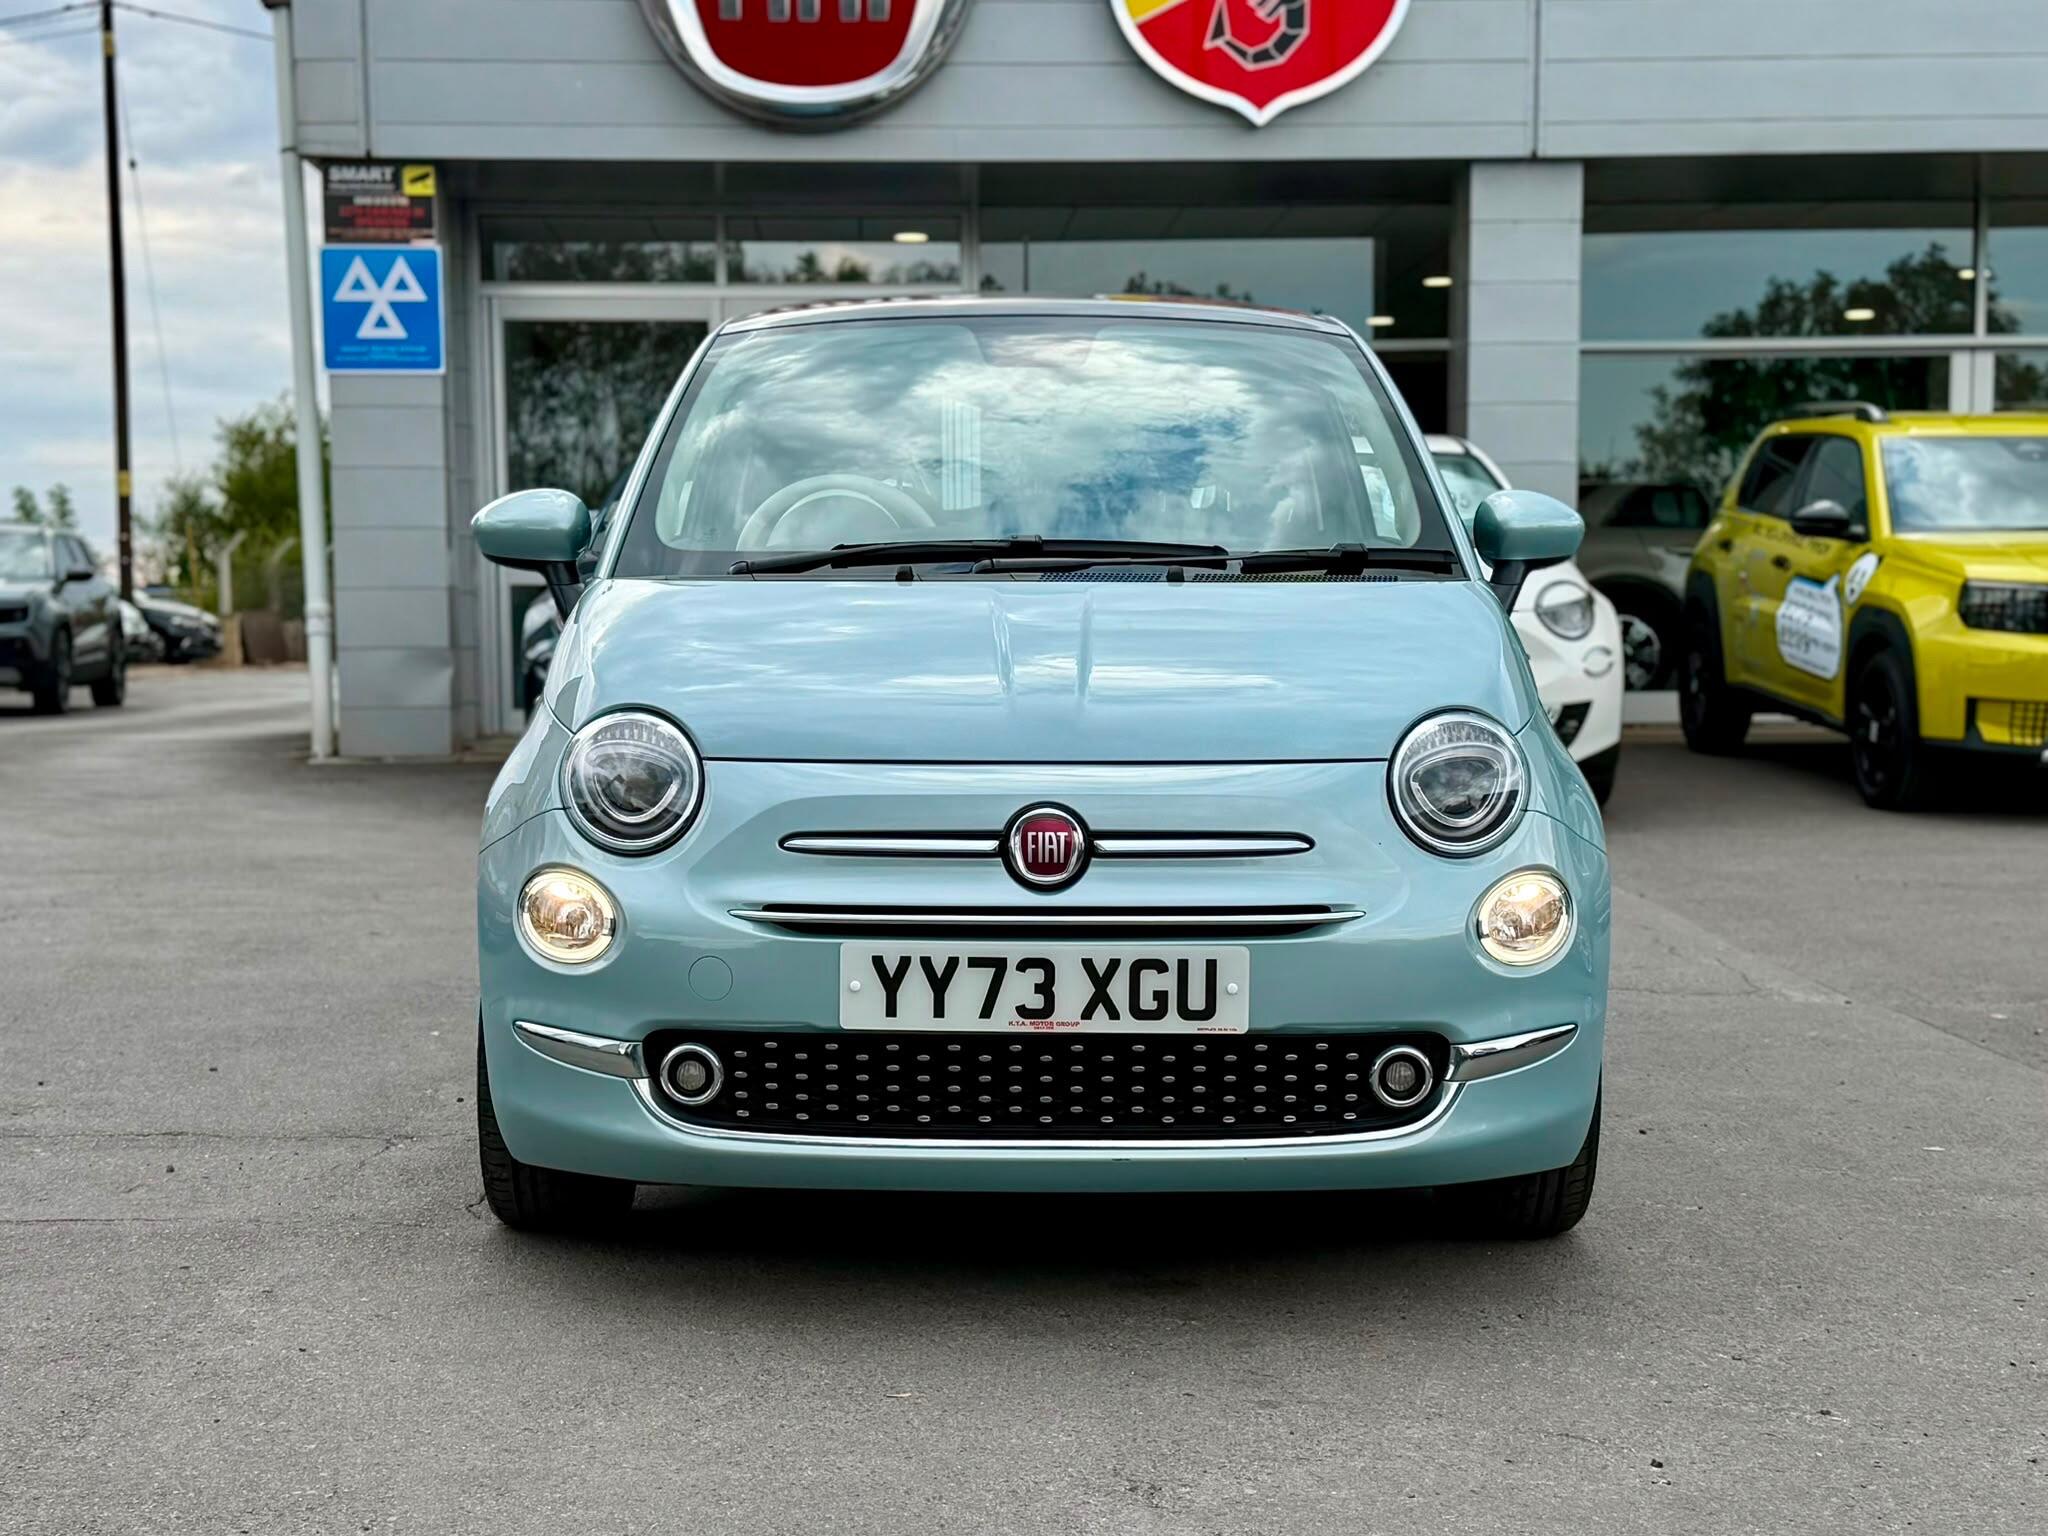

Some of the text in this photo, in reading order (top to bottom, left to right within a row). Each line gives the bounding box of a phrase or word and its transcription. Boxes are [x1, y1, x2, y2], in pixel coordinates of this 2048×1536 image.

[1027, 831, 1069, 864] FIAT
[871, 954, 1218, 1021] YY73 XGU
